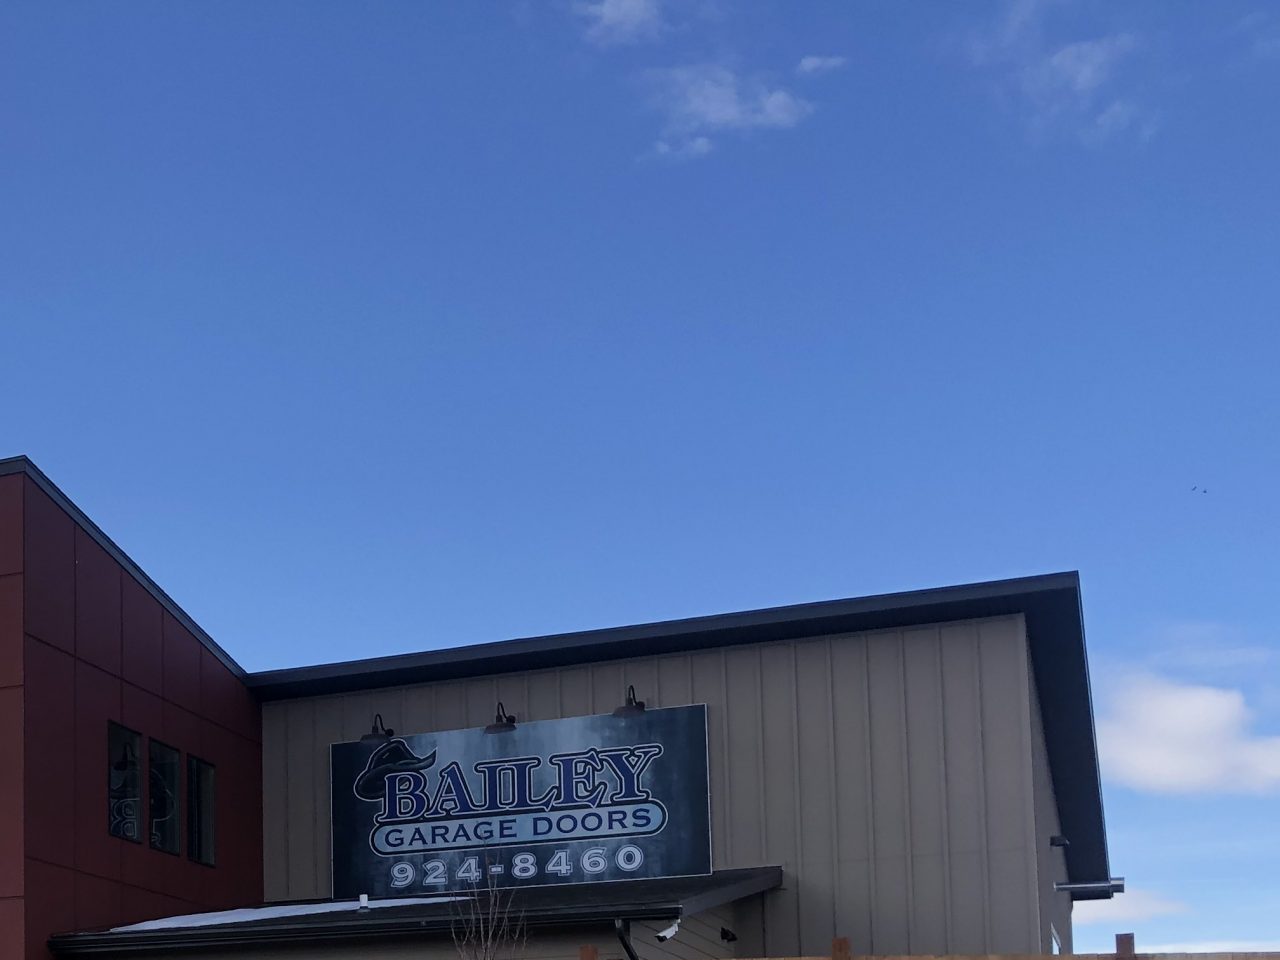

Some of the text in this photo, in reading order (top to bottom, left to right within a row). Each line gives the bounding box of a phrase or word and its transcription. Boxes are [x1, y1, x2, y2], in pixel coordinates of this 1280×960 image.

[378, 746, 662, 822] BAILEY
[384, 808, 652, 848] GARAGE DOORS
[390, 844, 644, 888] 924-8460
